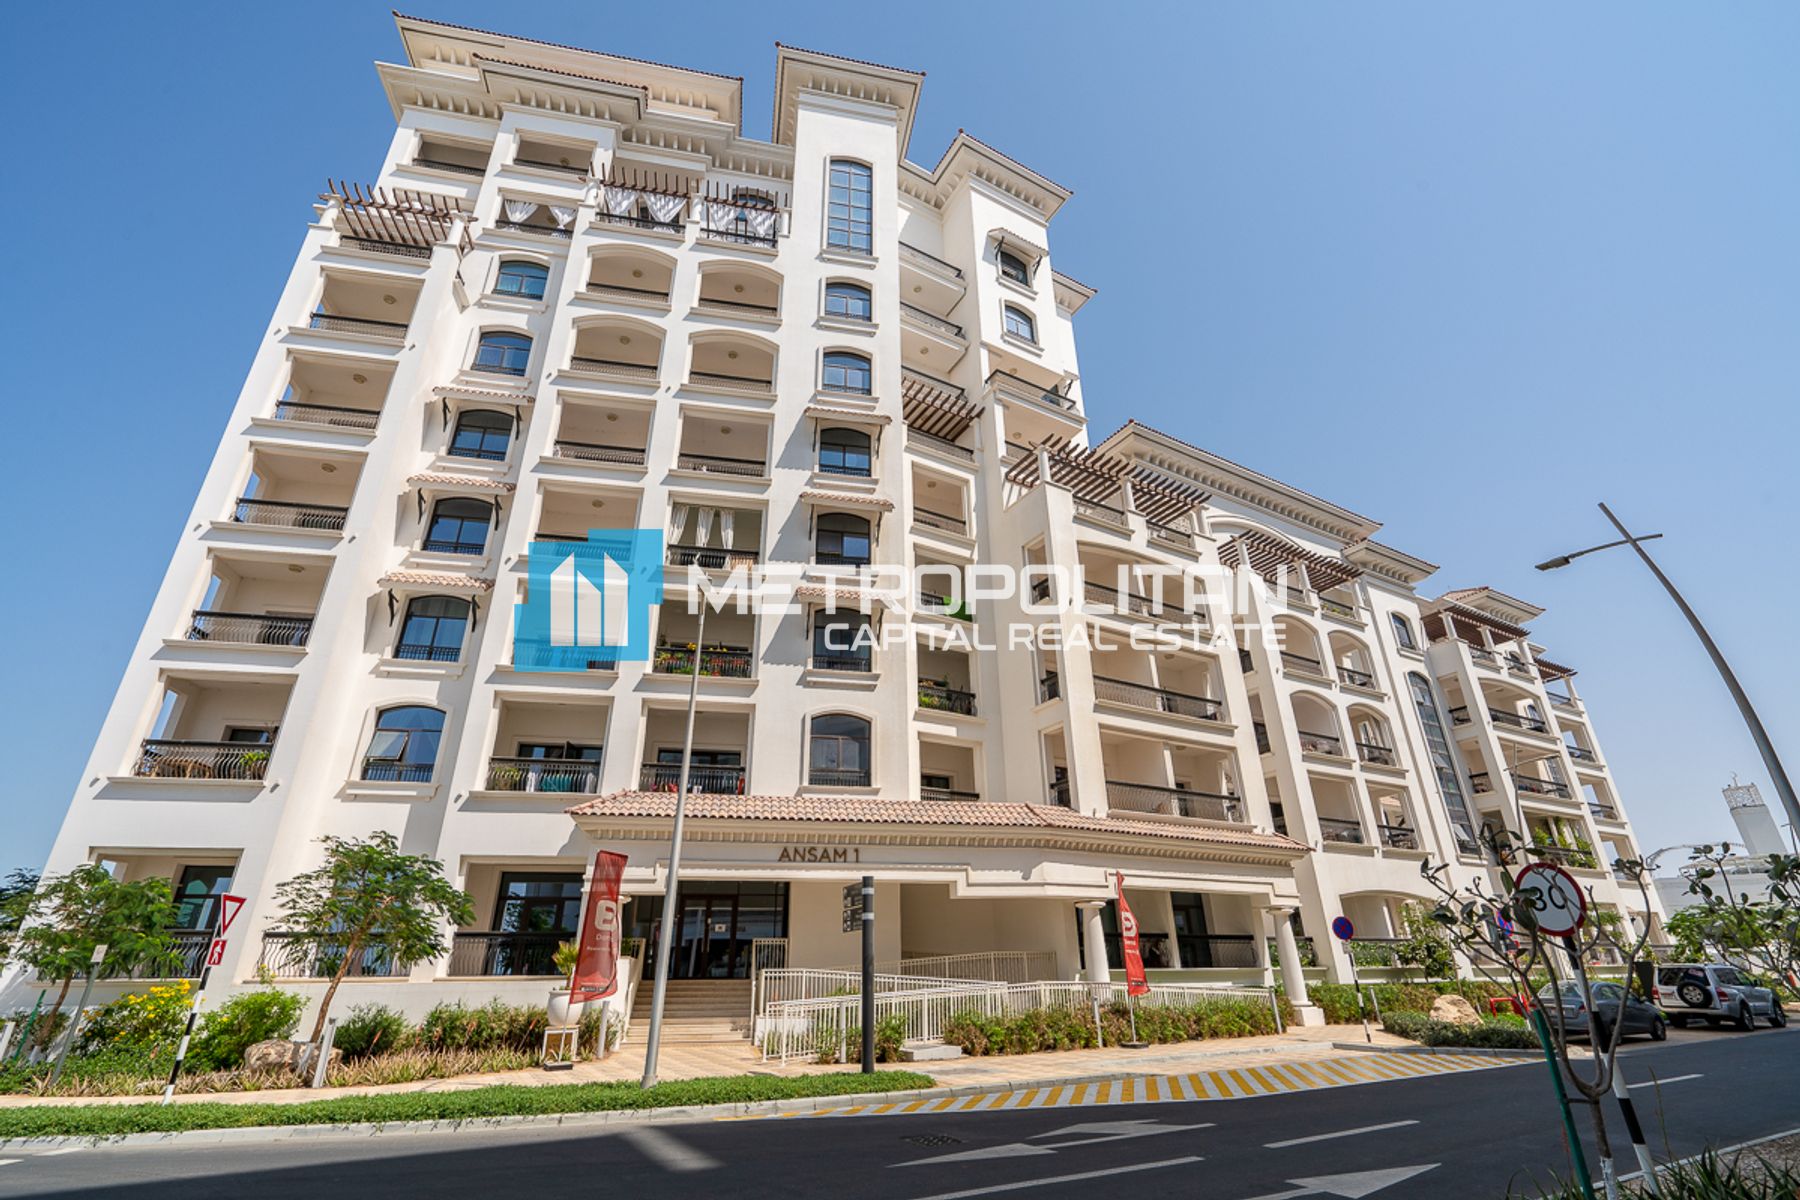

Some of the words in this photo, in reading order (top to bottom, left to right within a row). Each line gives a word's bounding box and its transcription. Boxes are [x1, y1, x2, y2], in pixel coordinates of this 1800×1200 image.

[778, 847, 847, 863] ANSAM
[853, 848, 859, 863] 1
[1530, 885, 1567, 911] 30
